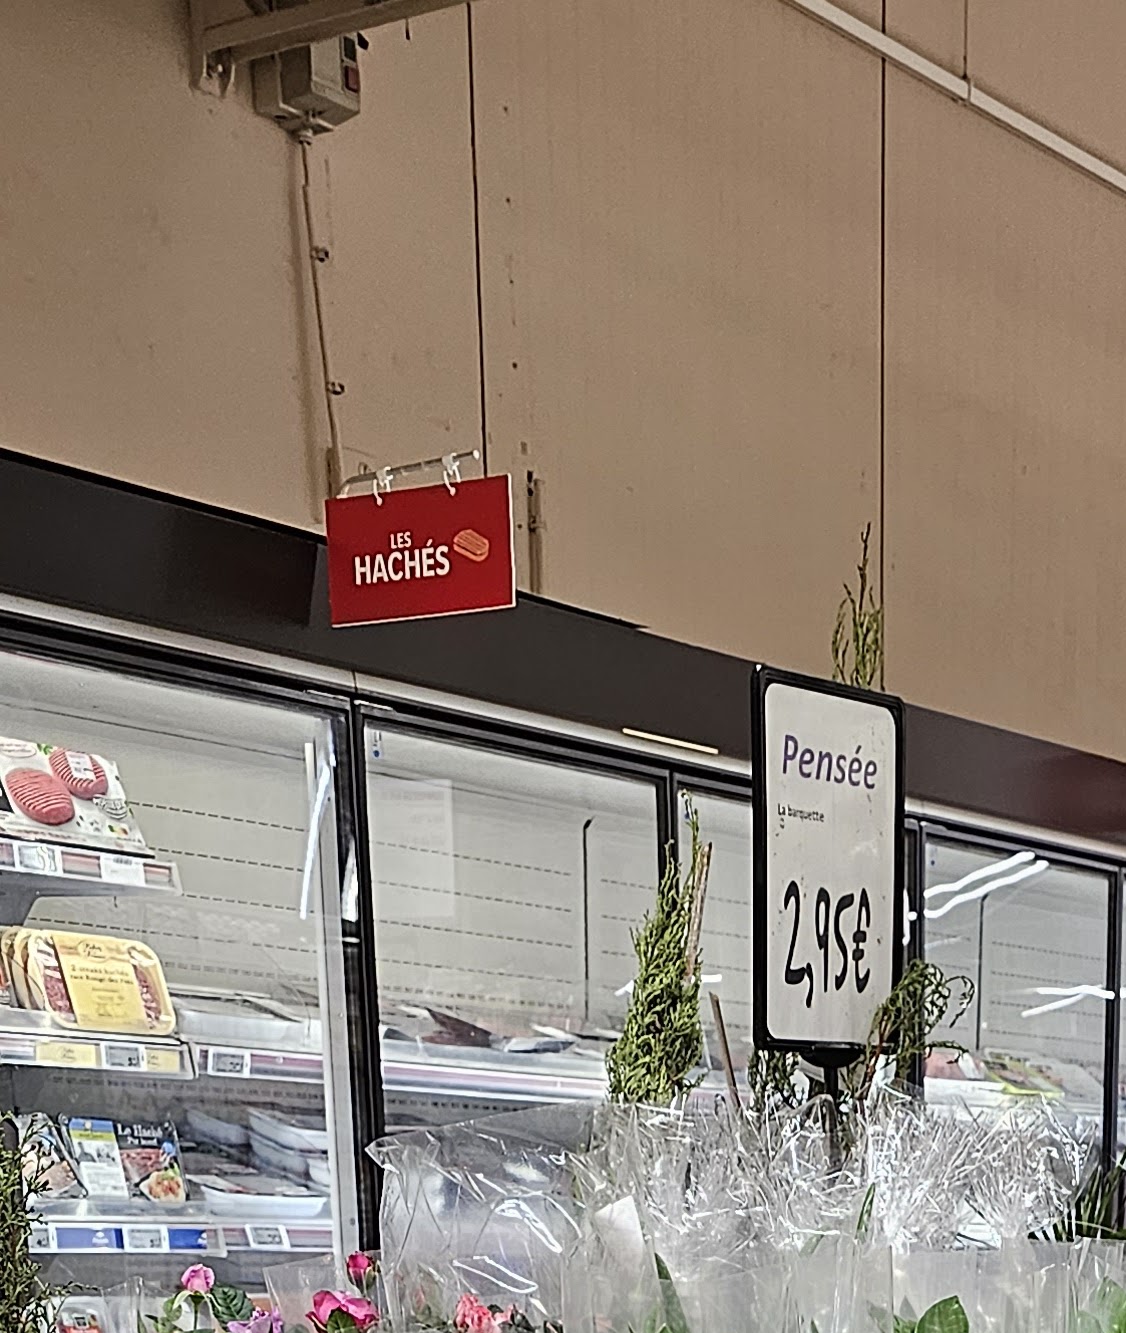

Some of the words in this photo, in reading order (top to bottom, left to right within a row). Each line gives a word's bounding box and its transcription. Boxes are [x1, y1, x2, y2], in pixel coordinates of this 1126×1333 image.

[390, 531, 412, 549] LES
[354, 539, 450, 585] HACHÉS
[782, 734, 878, 790] Pensée
[777, 803, 786, 817] La
[787, 805, 825, 823] barquette
